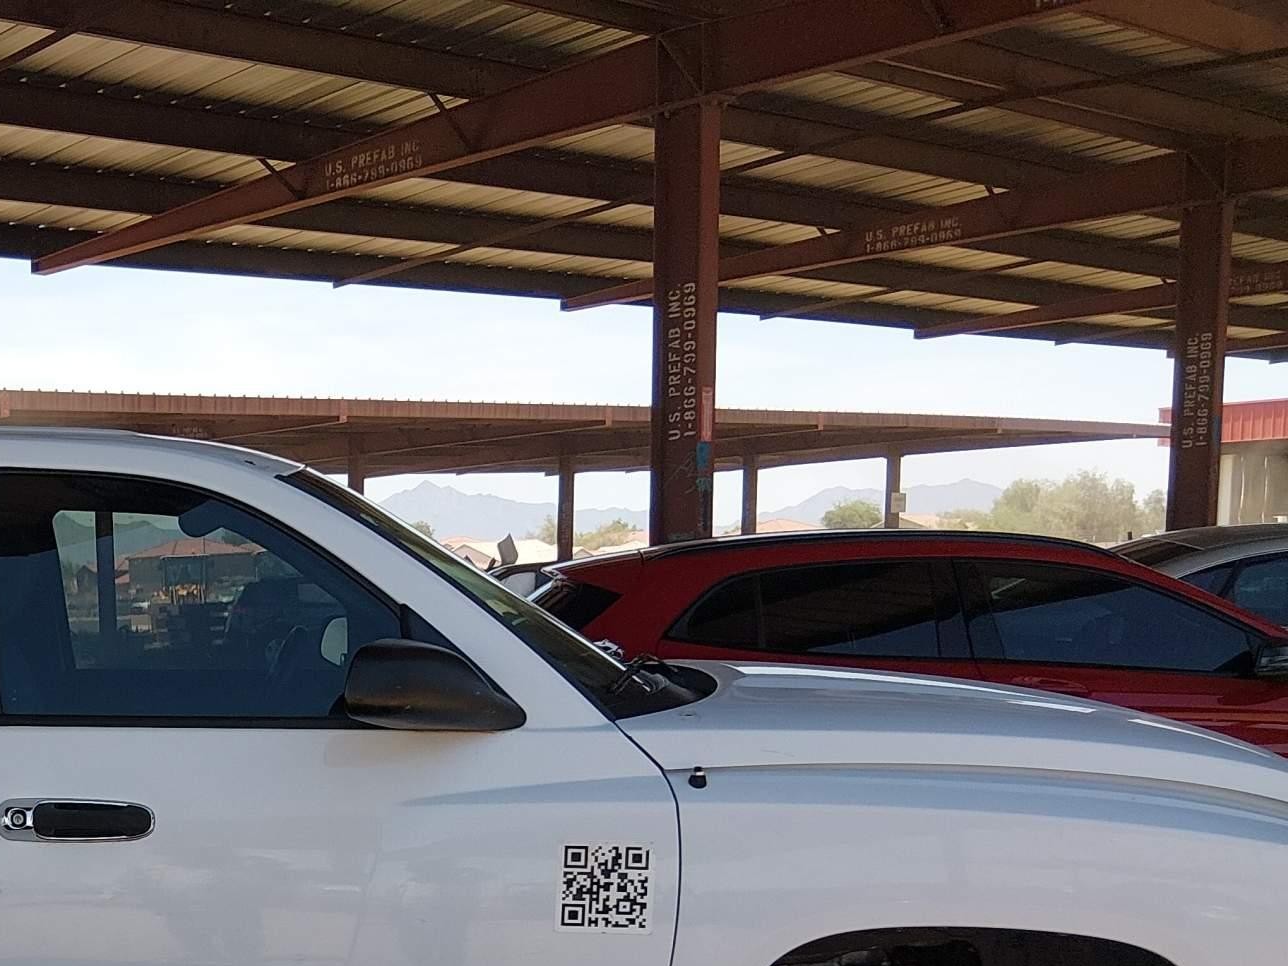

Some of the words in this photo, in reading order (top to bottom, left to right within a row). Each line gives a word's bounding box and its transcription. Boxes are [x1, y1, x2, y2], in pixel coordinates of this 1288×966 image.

[351, 145, 396, 169] PREFAB
[891, 220, 936, 238] PREFAB
[668, 283, 682, 318] INC.
[668, 327, 682, 397] PREFAB
[683, 282, 697, 436] 1-866-799-0969
[1184, 365, 1197, 416] PREFAB
[668, 406, 682, 441] U.S.
